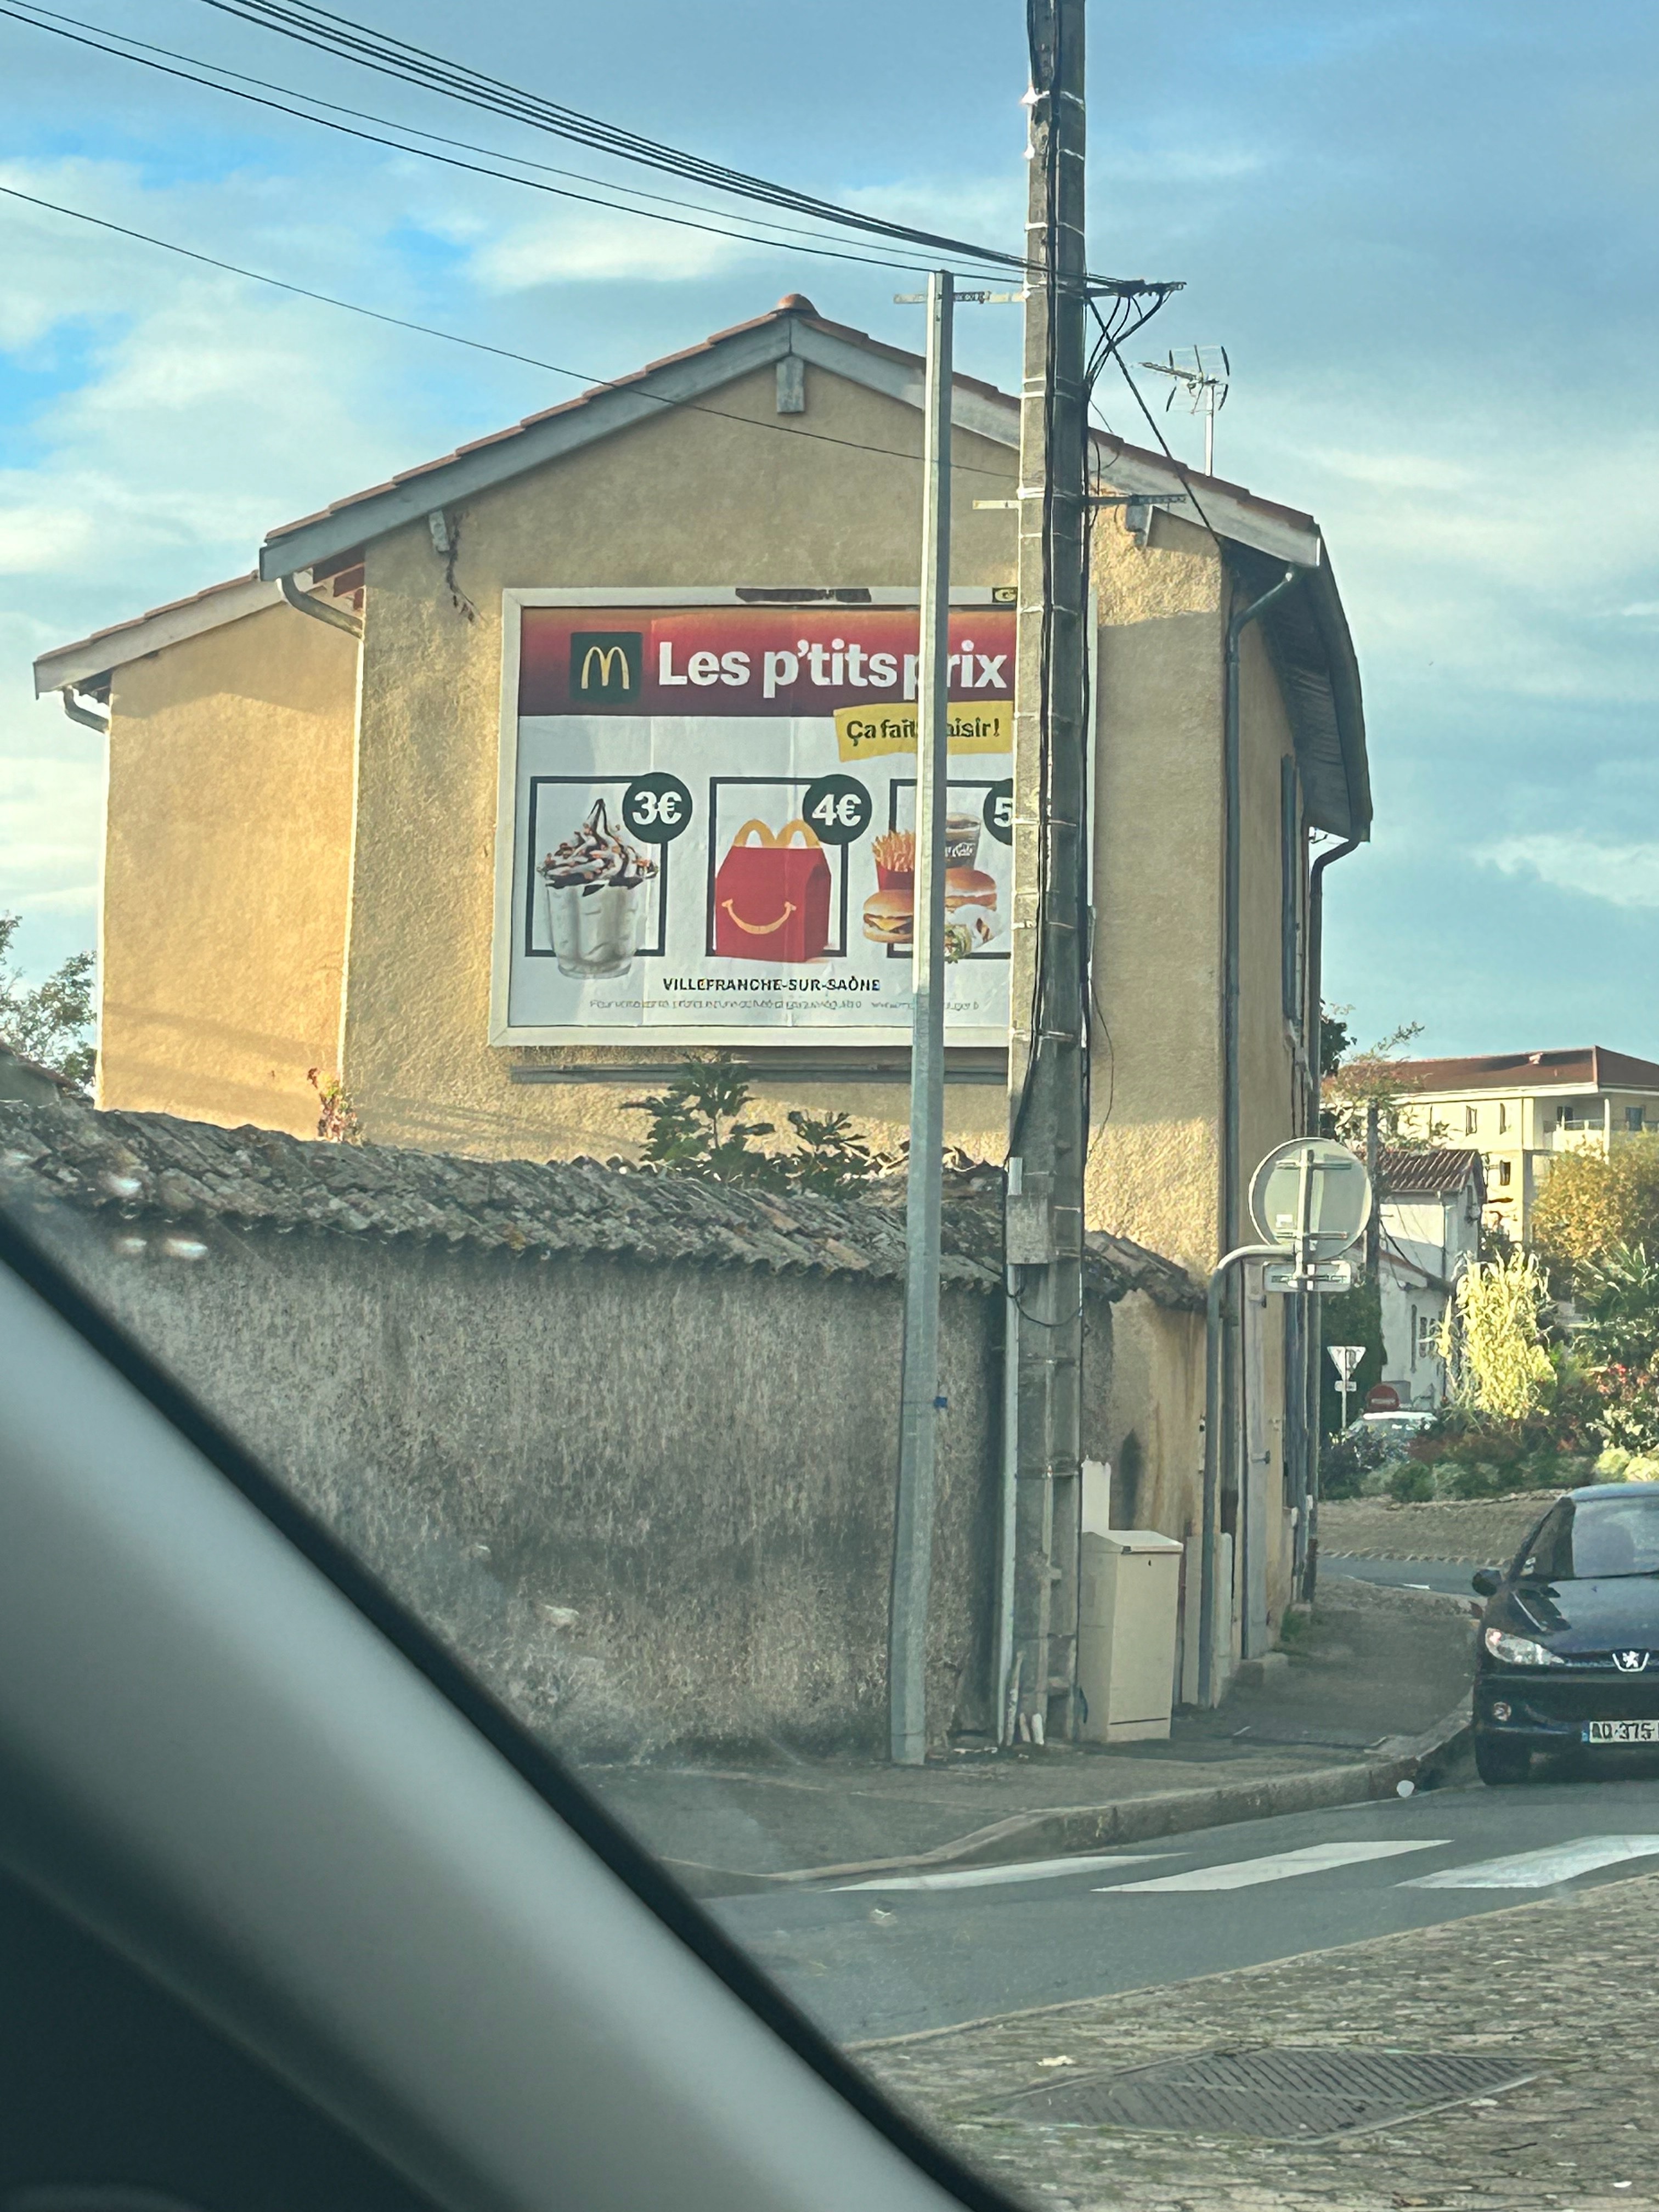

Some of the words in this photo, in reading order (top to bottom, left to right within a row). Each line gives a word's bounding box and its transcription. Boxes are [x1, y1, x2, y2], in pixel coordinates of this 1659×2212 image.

[659, 641, 751, 686] Les
[763, 638, 897, 698] p'tits
[847, 720, 876, 747] Ça
[880, 718, 916, 738] fait
[916, 716, 1000, 737] aisir!
[632, 791, 682, 825] 3€
[811, 794, 861, 827] 4€
[994, 797, 1013, 828] 5
